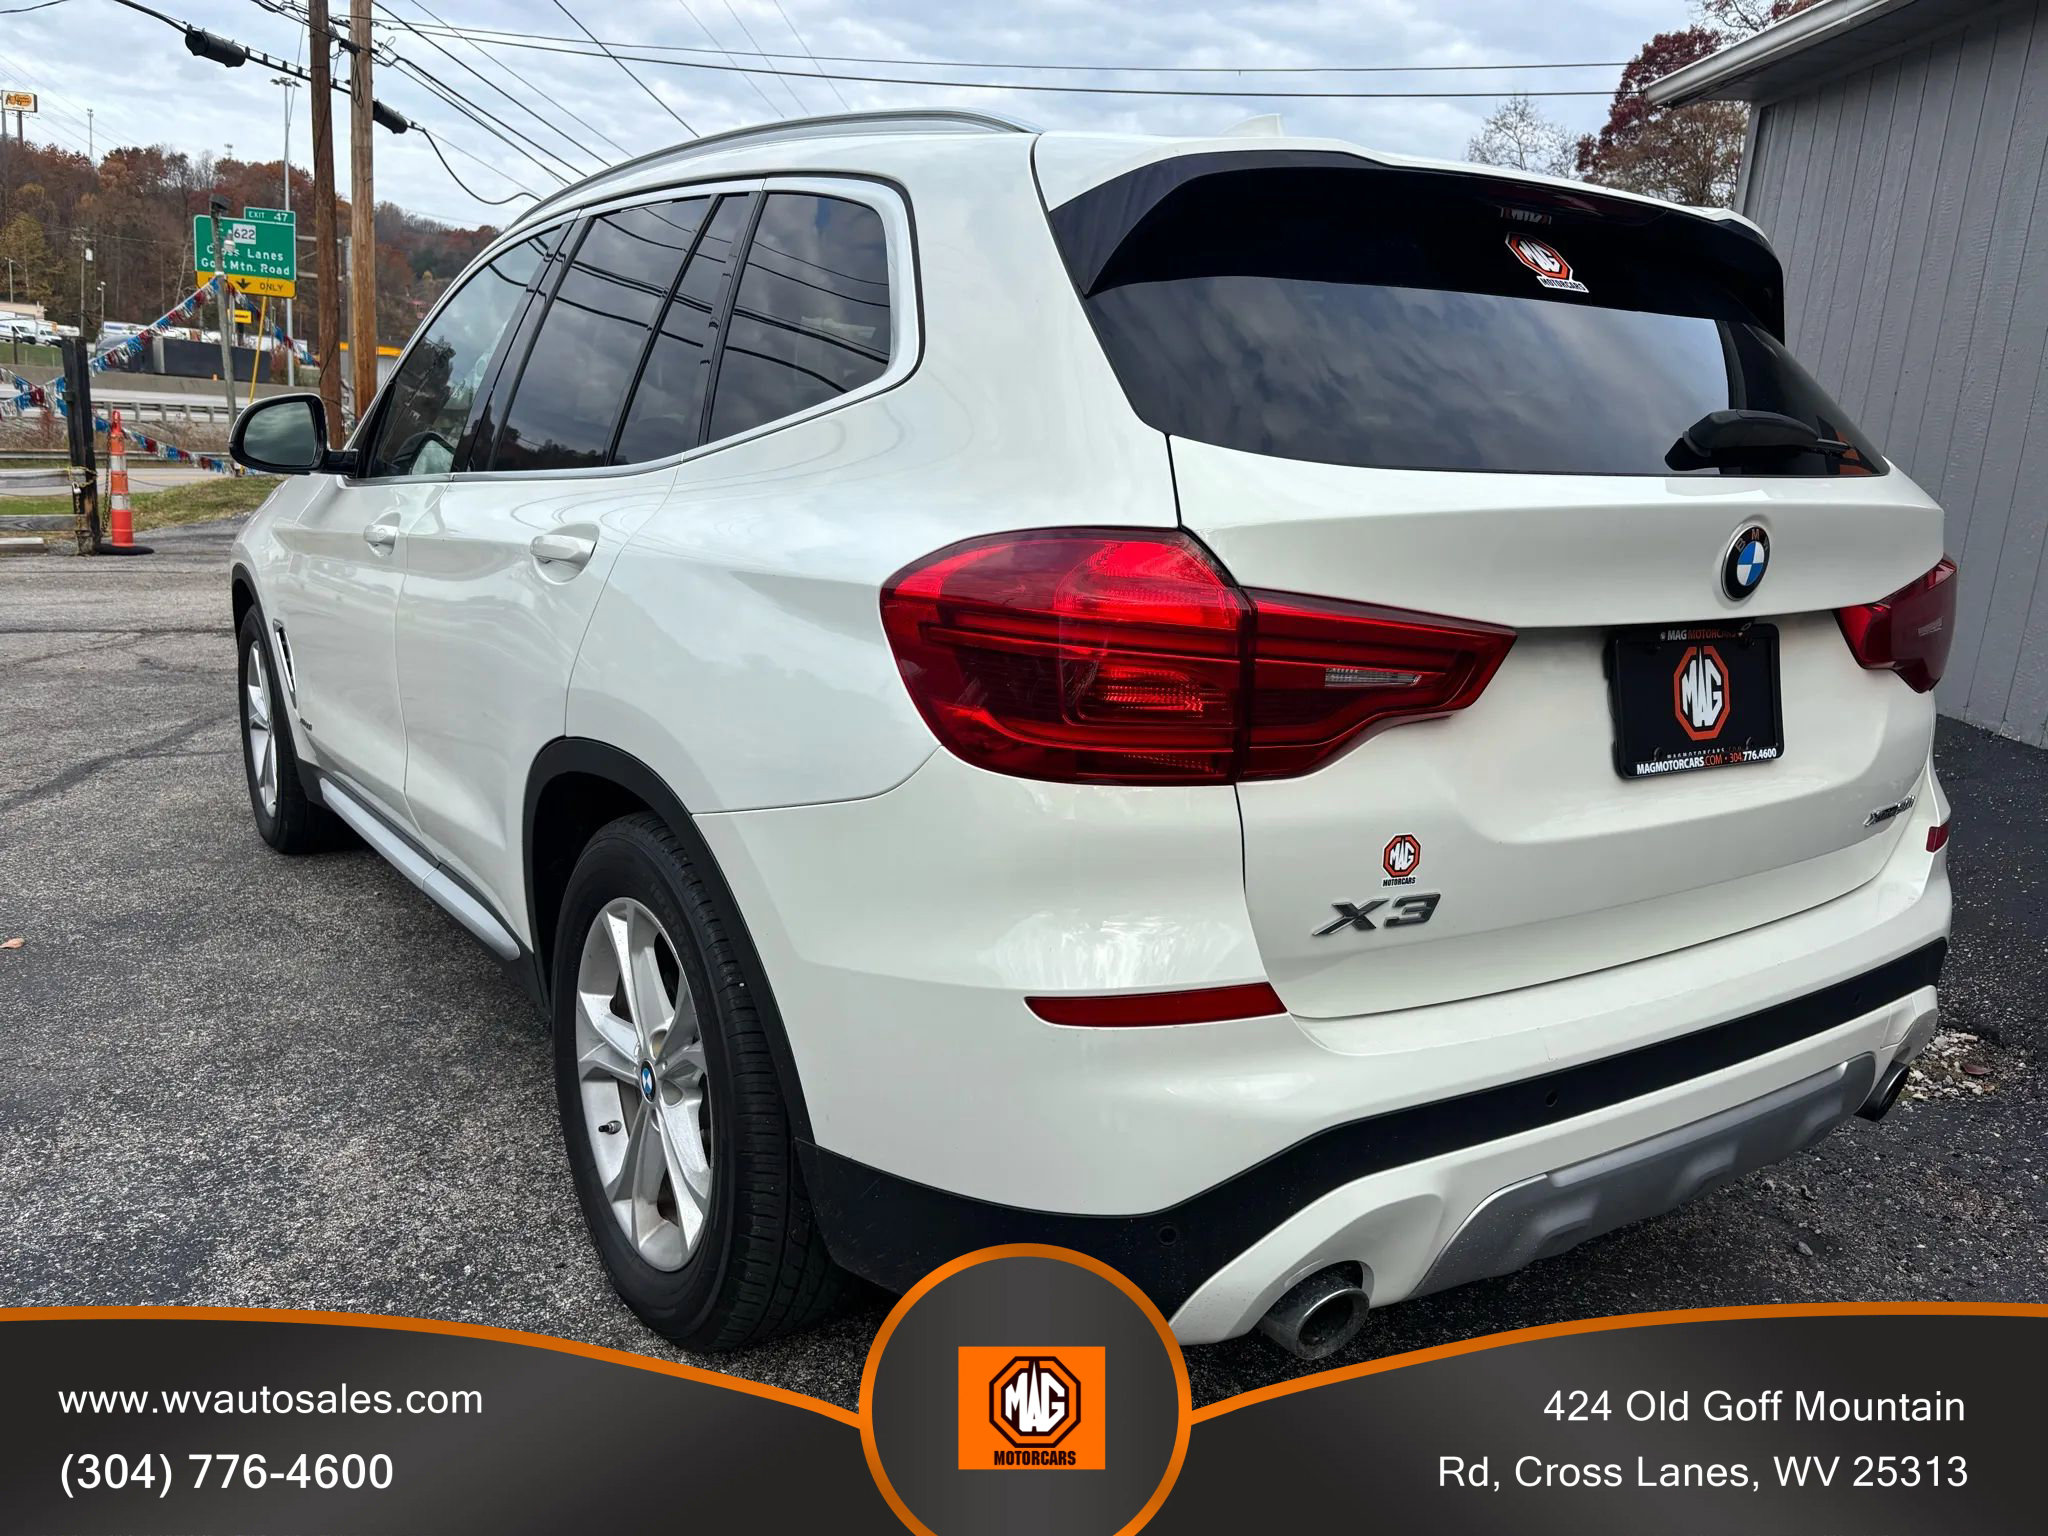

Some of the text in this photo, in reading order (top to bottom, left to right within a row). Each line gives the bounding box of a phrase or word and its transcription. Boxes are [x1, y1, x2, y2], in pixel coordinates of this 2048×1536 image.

[248, 211, 288, 222] EXIT 47
[233, 228, 256, 240] 622
[247, 248, 284, 261] Lanes
[230, 260, 256, 272] Mtn.
[260, 263, 290, 275] Road
[259, 282, 284, 292] ONLY
[1681, 647, 1723, 728] MAG
[1390, 837, 1415, 871] MAG
[1382, 877, 1416, 887] MOTORCARS
[1311, 892, 1441, 936] X3
